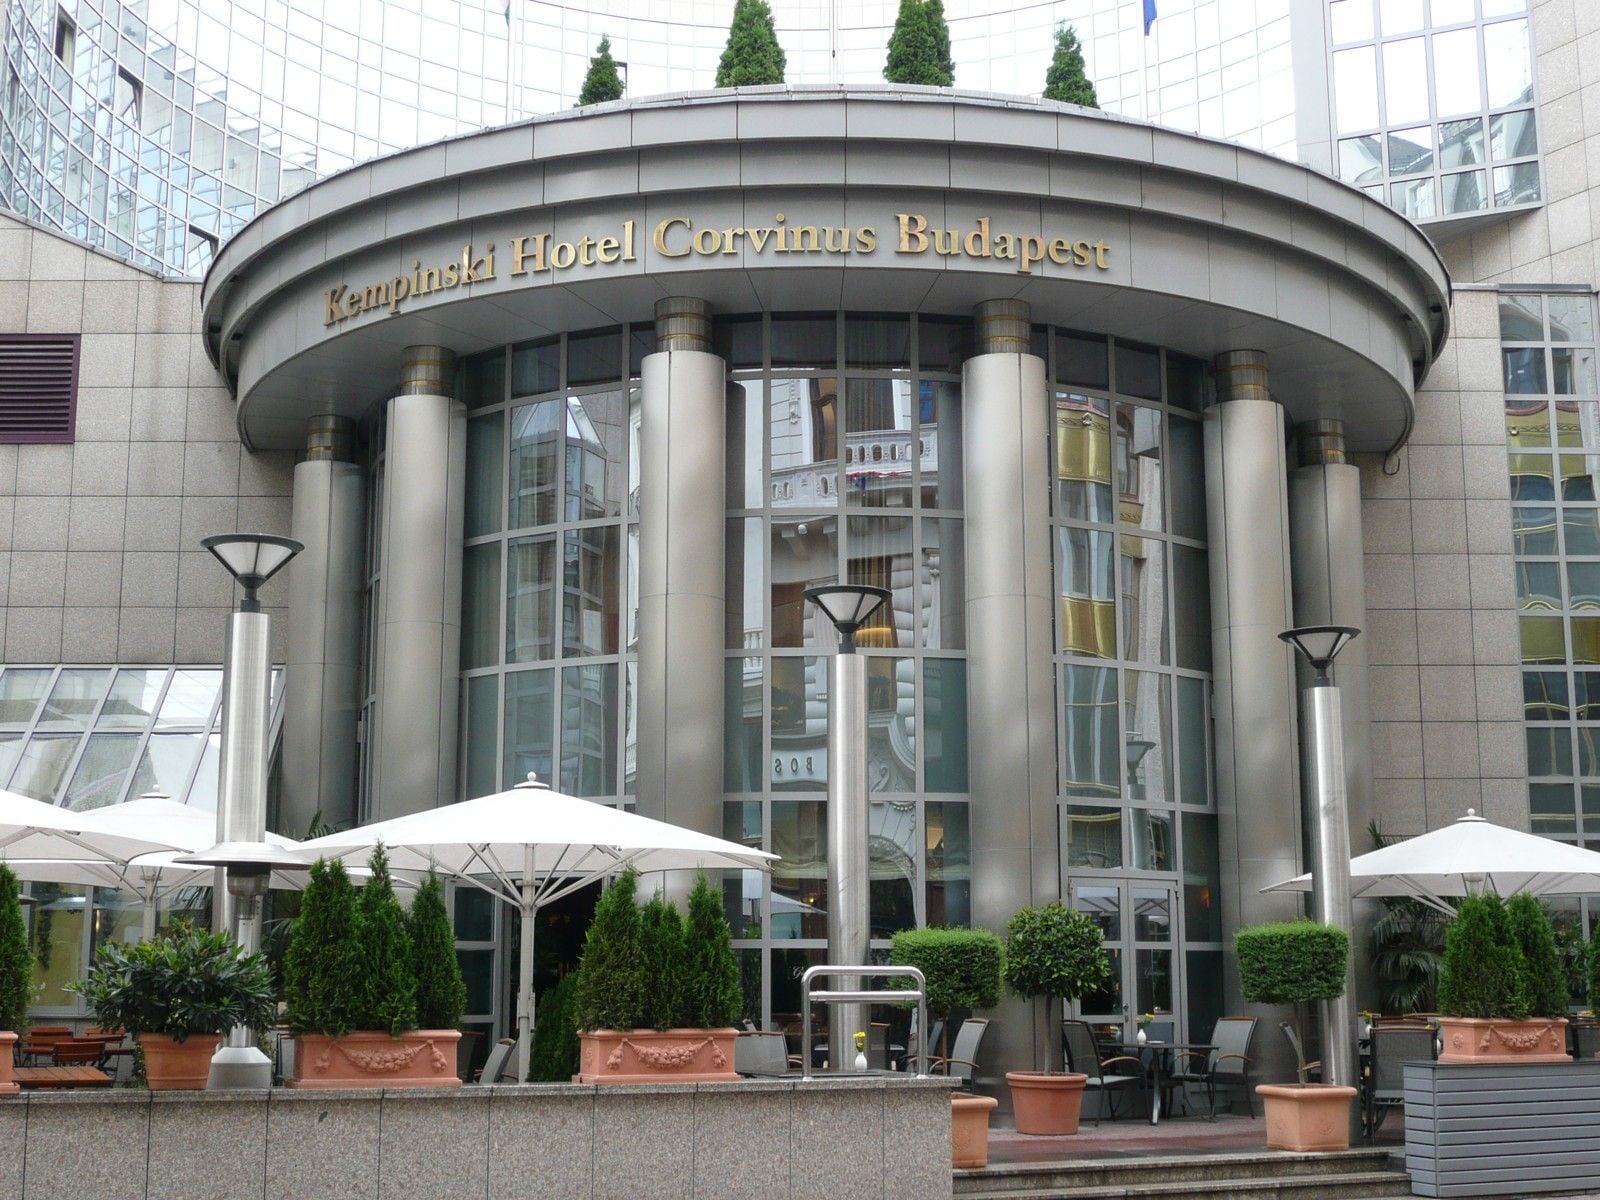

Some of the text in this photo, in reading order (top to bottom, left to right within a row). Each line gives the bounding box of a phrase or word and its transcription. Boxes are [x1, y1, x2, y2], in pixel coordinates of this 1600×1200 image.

[323, 212, 1111, 326] Kempinski Hotel Corvinus Budapest
